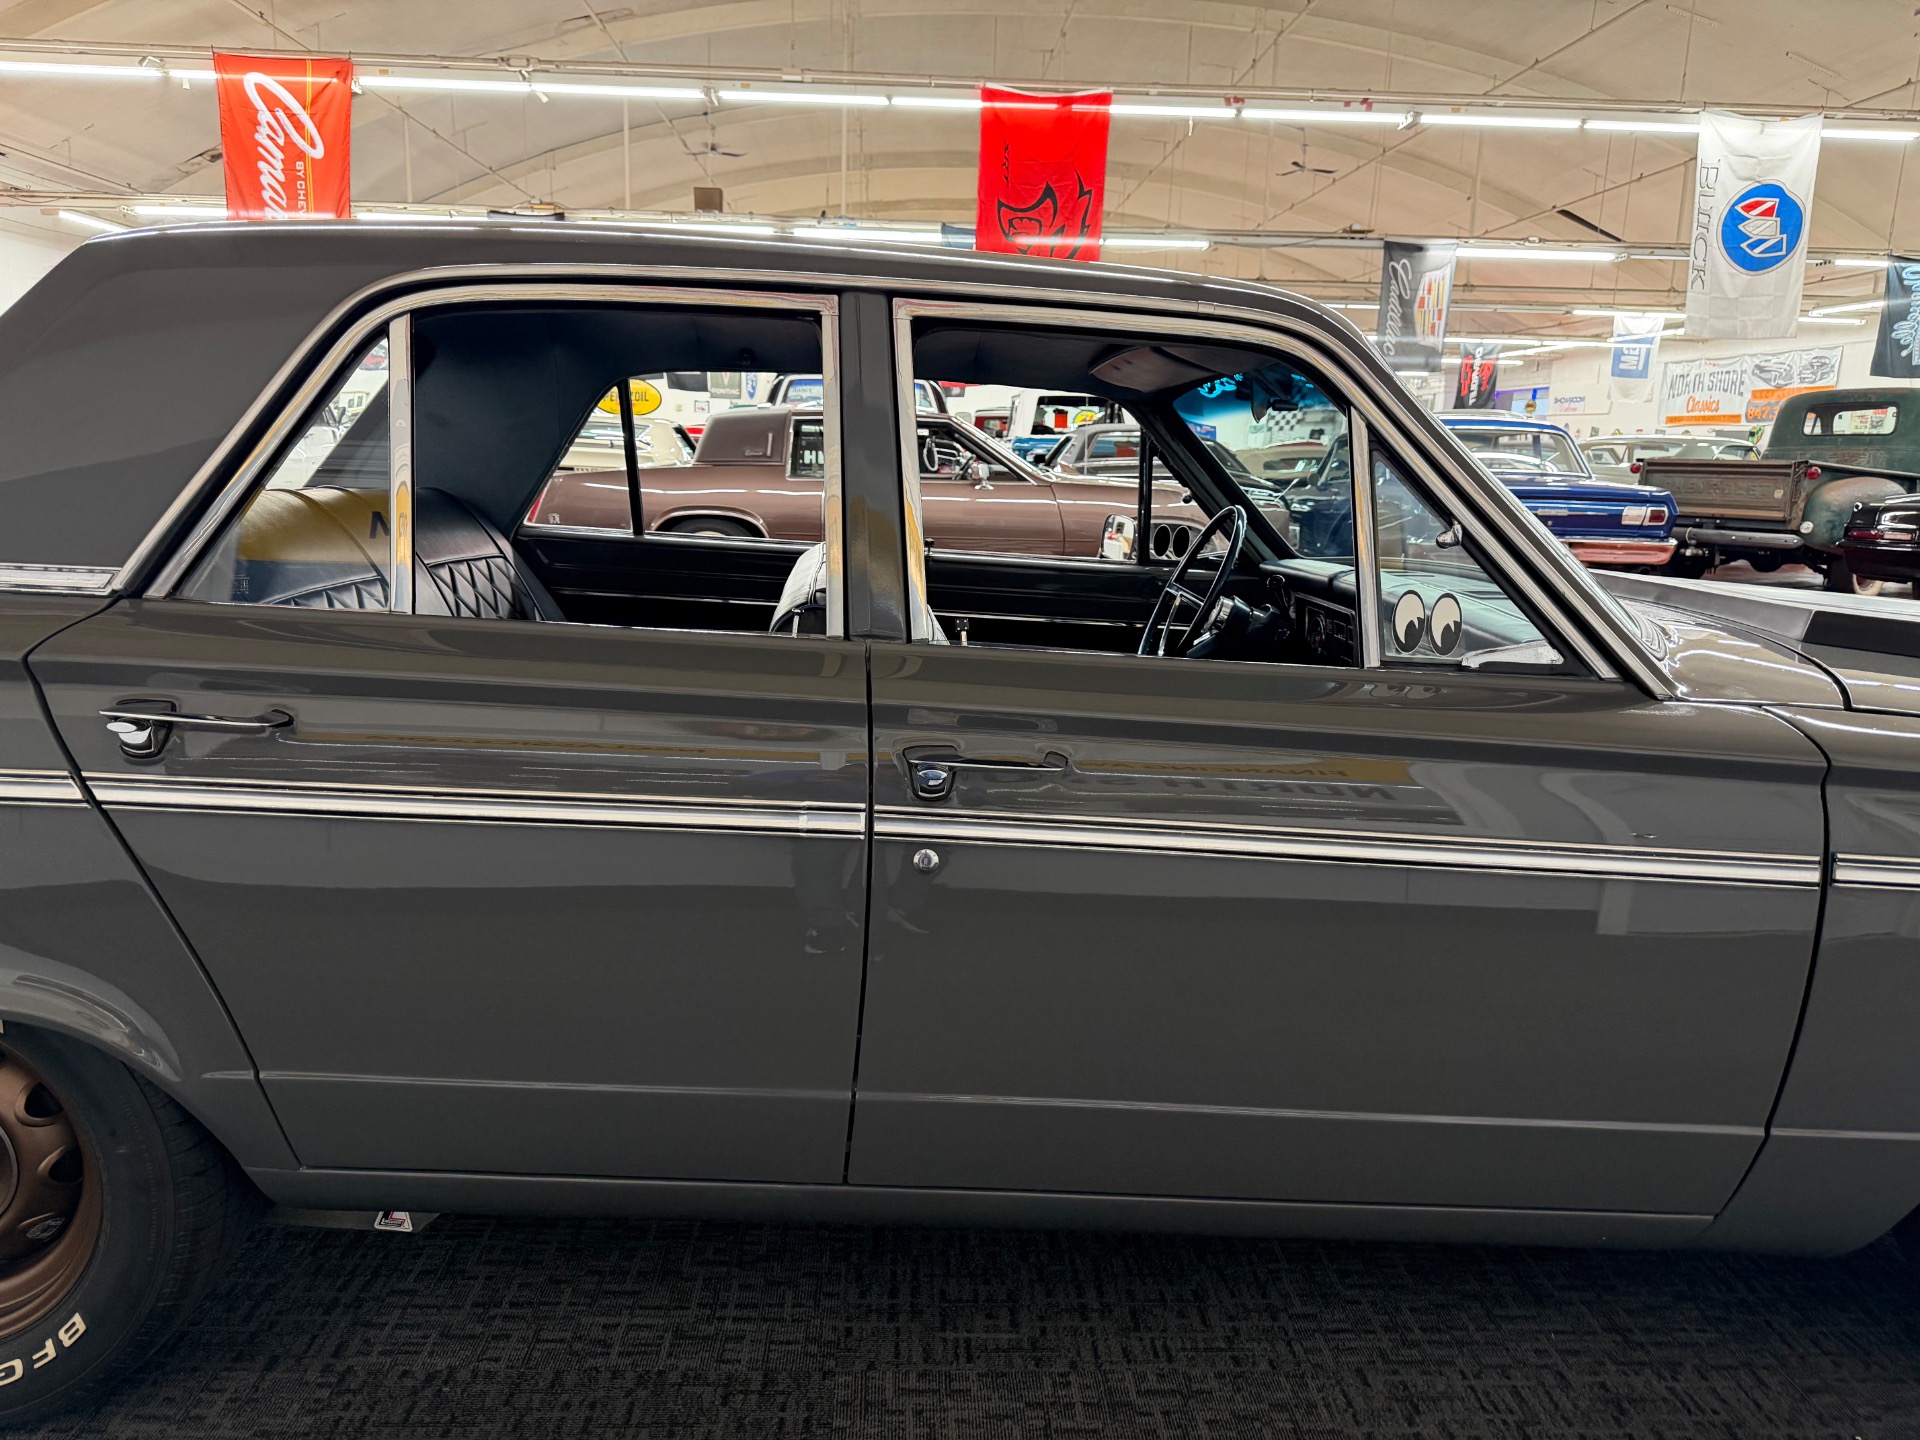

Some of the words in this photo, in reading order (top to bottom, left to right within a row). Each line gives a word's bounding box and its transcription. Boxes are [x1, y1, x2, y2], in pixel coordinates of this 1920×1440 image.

[295, 161, 304, 180] BY
[1691, 158, 1720, 290] BUICK
[1383, 258, 1412, 356] Cadillac
[1667, 371, 1706, 400] NORTH
[1708, 369, 1747, 397] SHORE
[1685, 394, 1720, 414] Classics
